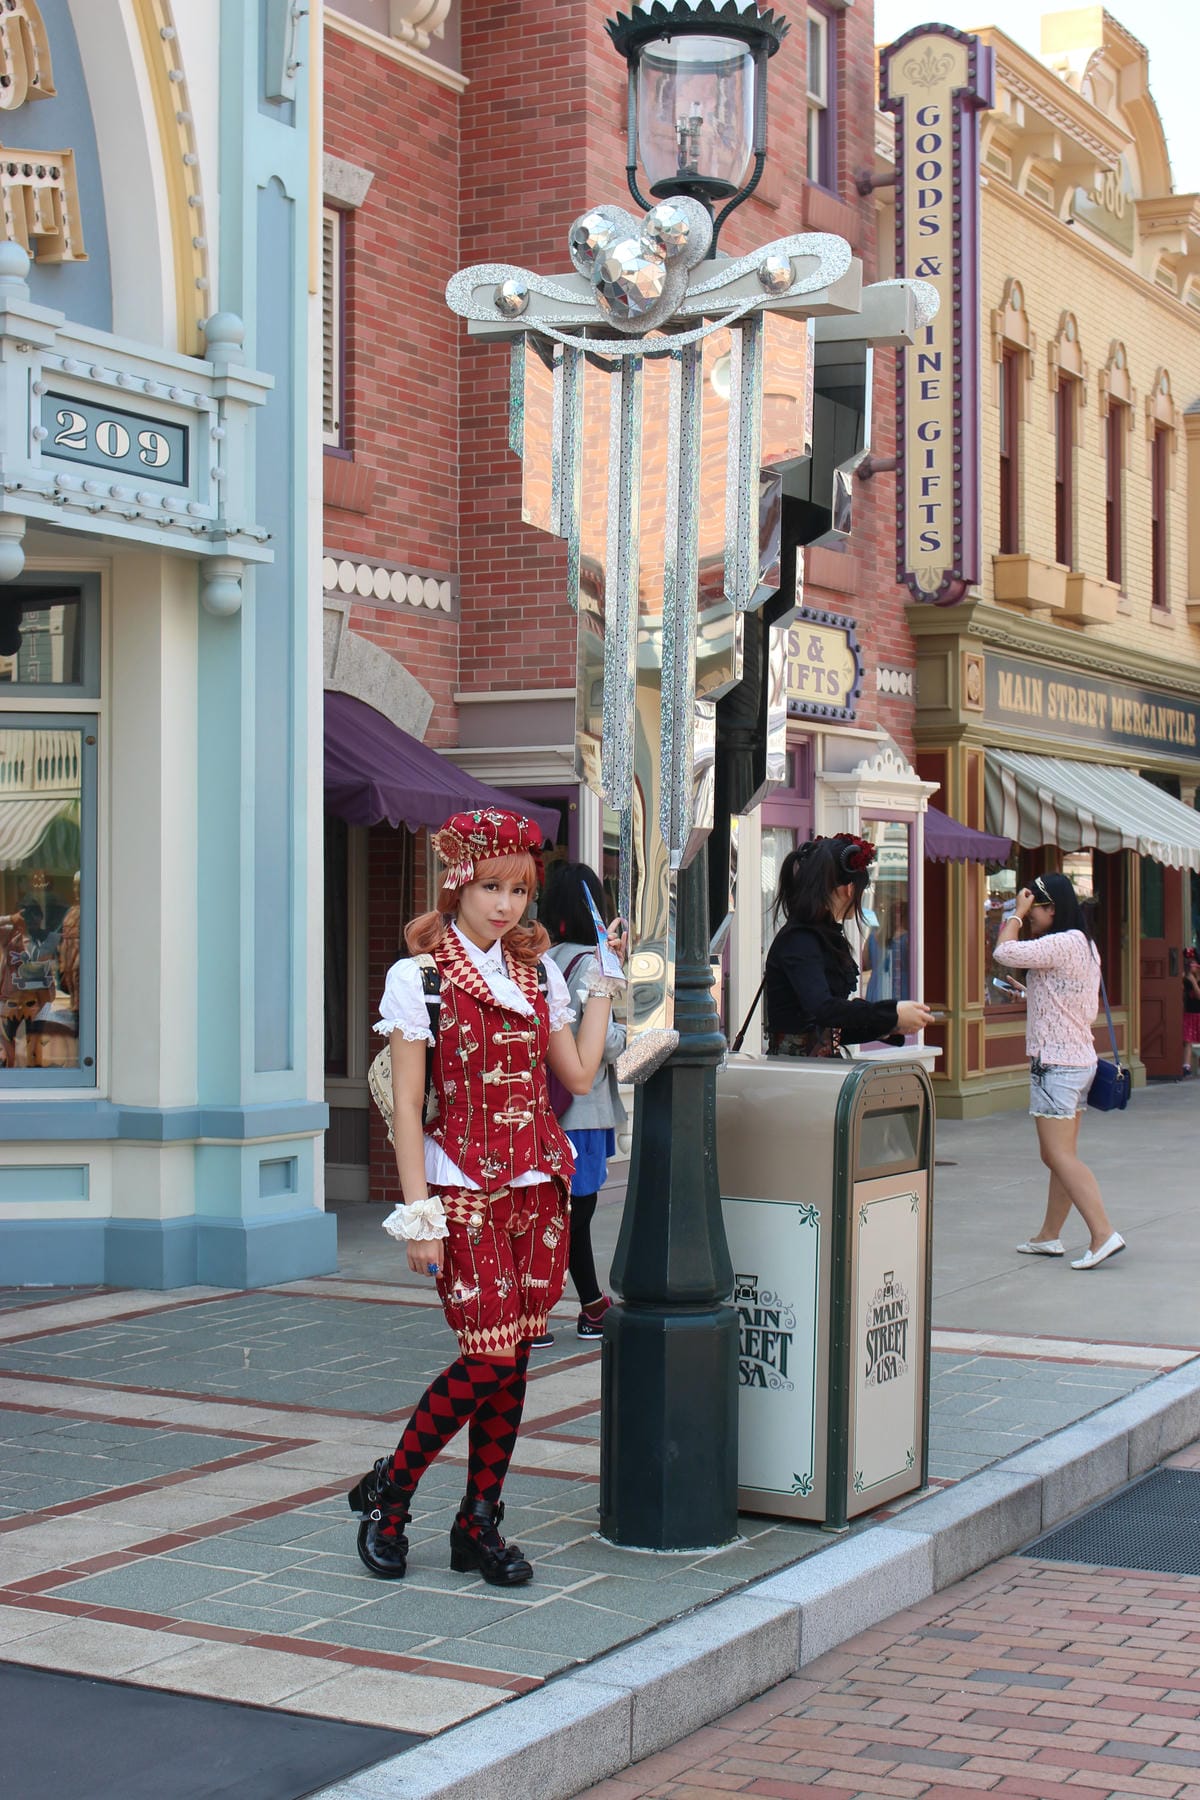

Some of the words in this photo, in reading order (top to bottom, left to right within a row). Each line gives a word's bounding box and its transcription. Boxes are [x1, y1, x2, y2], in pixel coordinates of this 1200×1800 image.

[915, 105, 943, 237] GOODS
[914, 255, 943, 278] &
[917, 325, 941, 400] INE
[54, 409, 171, 468] 209
[917, 420, 941, 552] GIFTS
[806, 634, 825, 663] &
[787, 661, 840, 696] IFTS
[998, 670, 1043, 718] MAIN
[1047, 681, 1108, 730] STREET
[1111, 696, 1197, 747] MERCANTILE
[738, 1306, 782, 1329] AIN
[872, 1299, 904, 1327] MAIN
[865, 1318, 909, 1378] STREET
[738, 1359, 769, 1388] SA
[876, 1356, 898, 1384] USA
